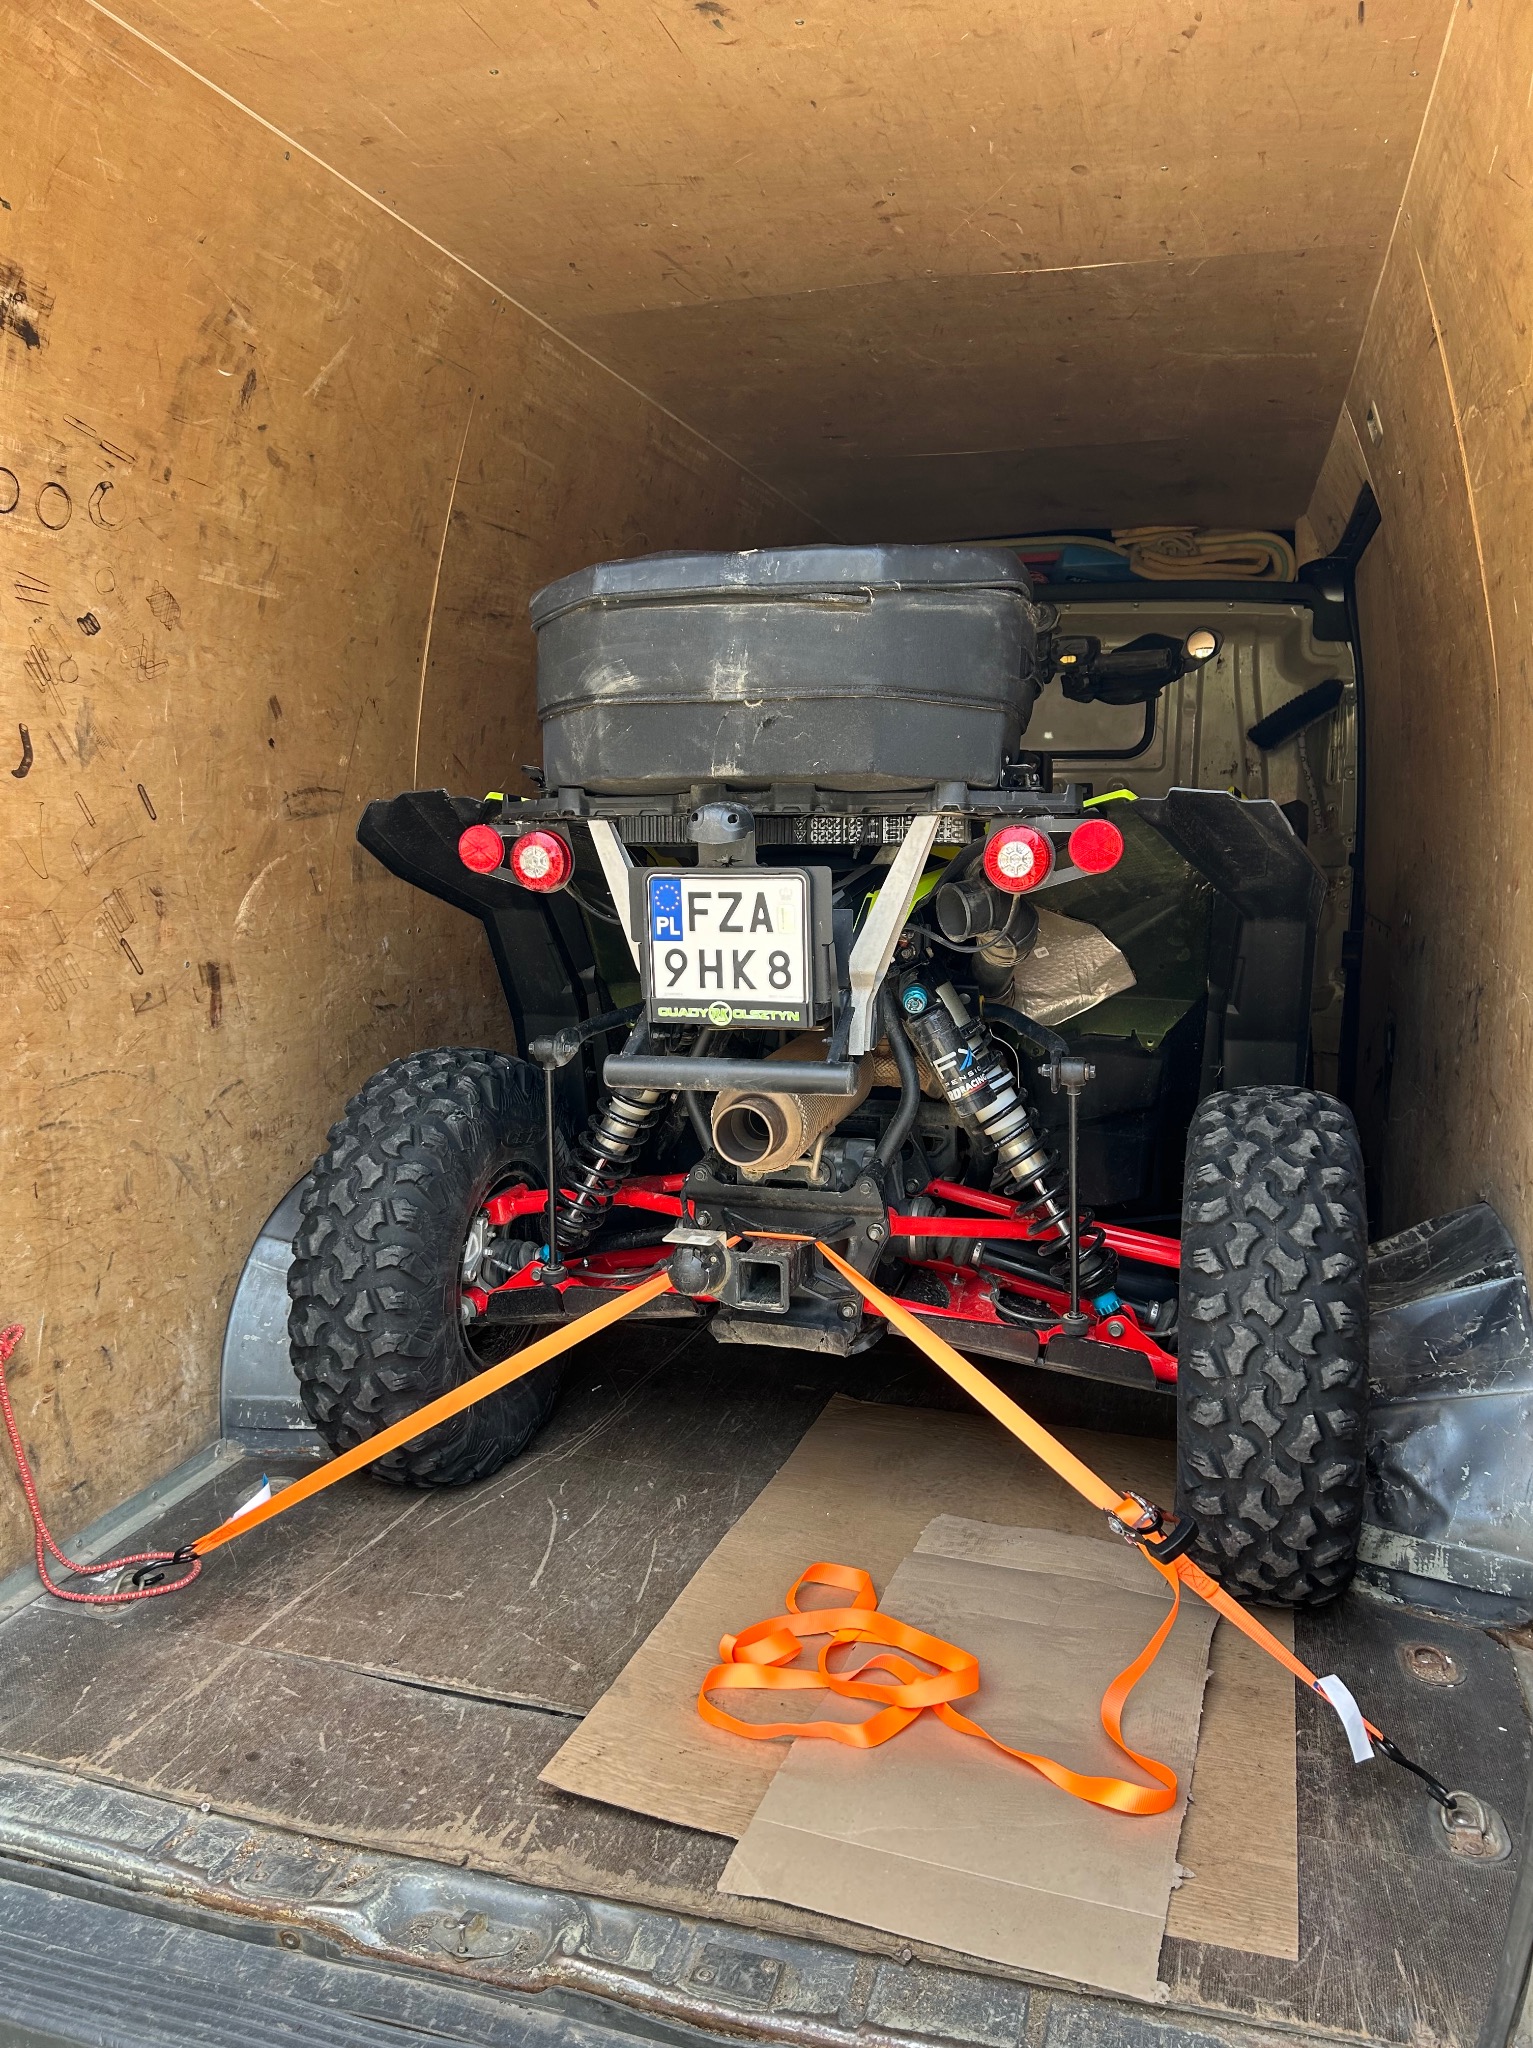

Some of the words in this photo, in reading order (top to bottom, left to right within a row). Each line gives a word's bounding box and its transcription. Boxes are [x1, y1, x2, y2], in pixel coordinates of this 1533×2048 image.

[656, 916, 681, 936] PL
[687, 891, 774, 933] FZA
[664, 948, 792, 990] 9HK8
[732, 1008, 800, 1022] OLSZTYN
